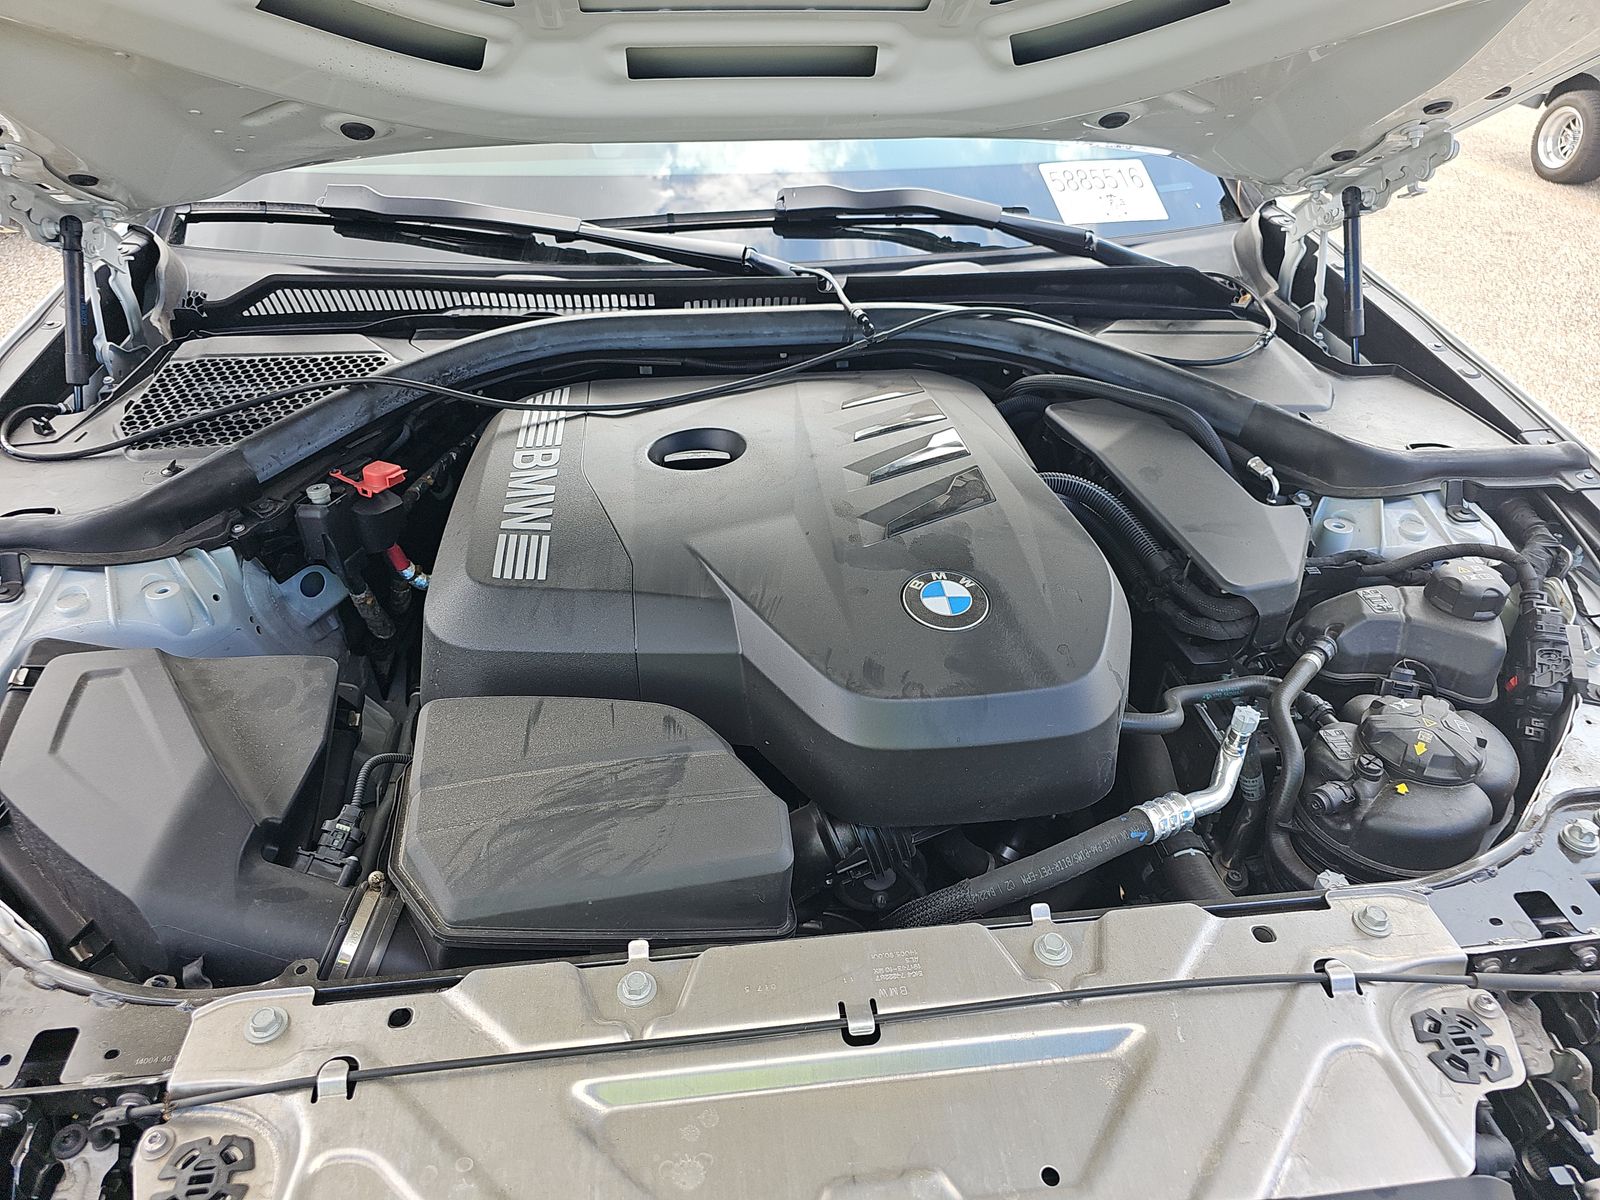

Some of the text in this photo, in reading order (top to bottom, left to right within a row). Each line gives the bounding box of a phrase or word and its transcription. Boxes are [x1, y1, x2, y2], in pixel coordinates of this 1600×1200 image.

[1050, 167, 1144, 192] 5885516
[500, 448, 561, 531] BMW
[909, 571, 976, 591] BMW
[879, 985, 908, 998] BMW
